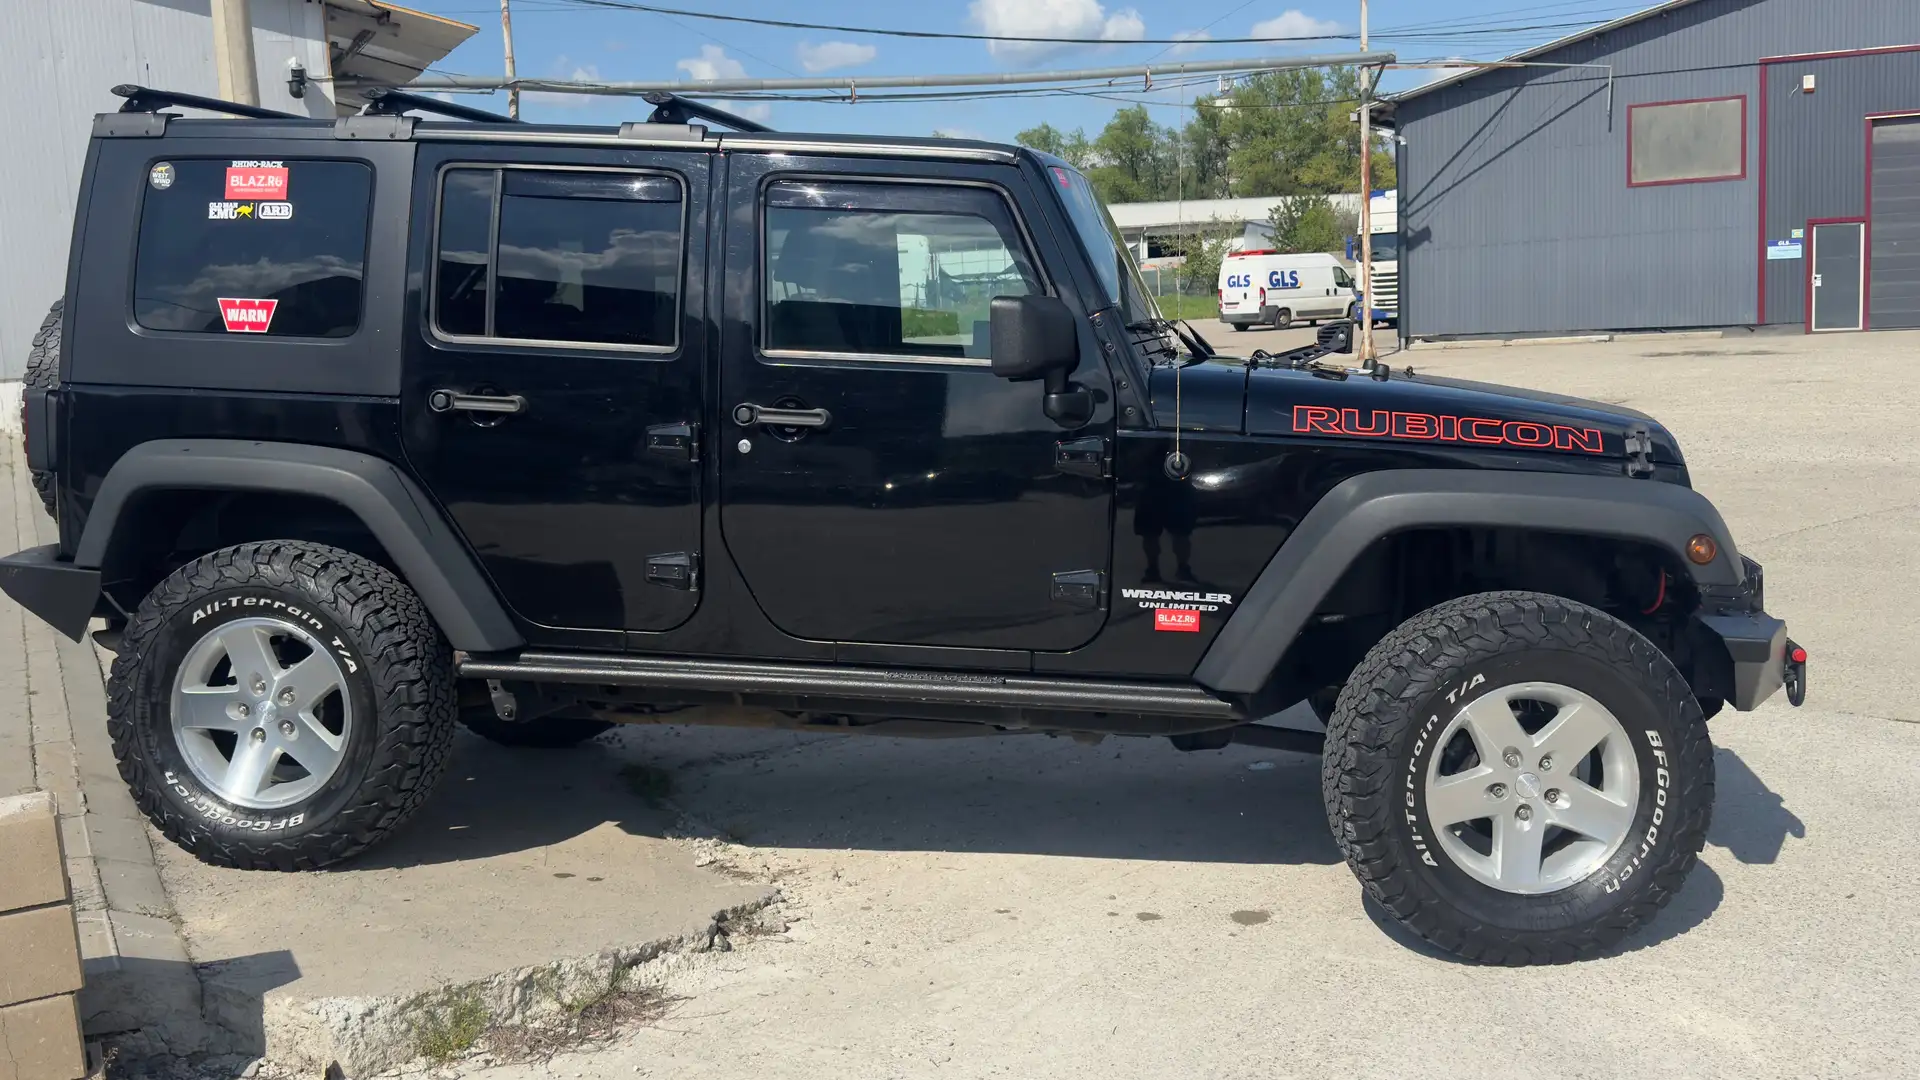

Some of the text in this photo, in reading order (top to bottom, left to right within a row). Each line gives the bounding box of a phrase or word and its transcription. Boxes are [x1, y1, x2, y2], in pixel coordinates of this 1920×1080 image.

[208, 208, 238, 219] EMU
[262, 205, 289, 216] ARB
[1227, 274, 1251, 288] GLS
[1269, 270, 1299, 287] GLS
[227, 308, 267, 322] WARN
[1292, 405, 1604, 452] RUBICON
[1121, 588, 1232, 604] WRANGLER
[1138, 602, 1218, 611] UNLIMITED
[192, 596, 358, 674] All-Terrain T/A
[1405, 673, 1486, 867] All-Terrain T/A
[164, 771, 305, 832] BFGoodrich
[1605, 730, 1670, 895] BFGoodrich
